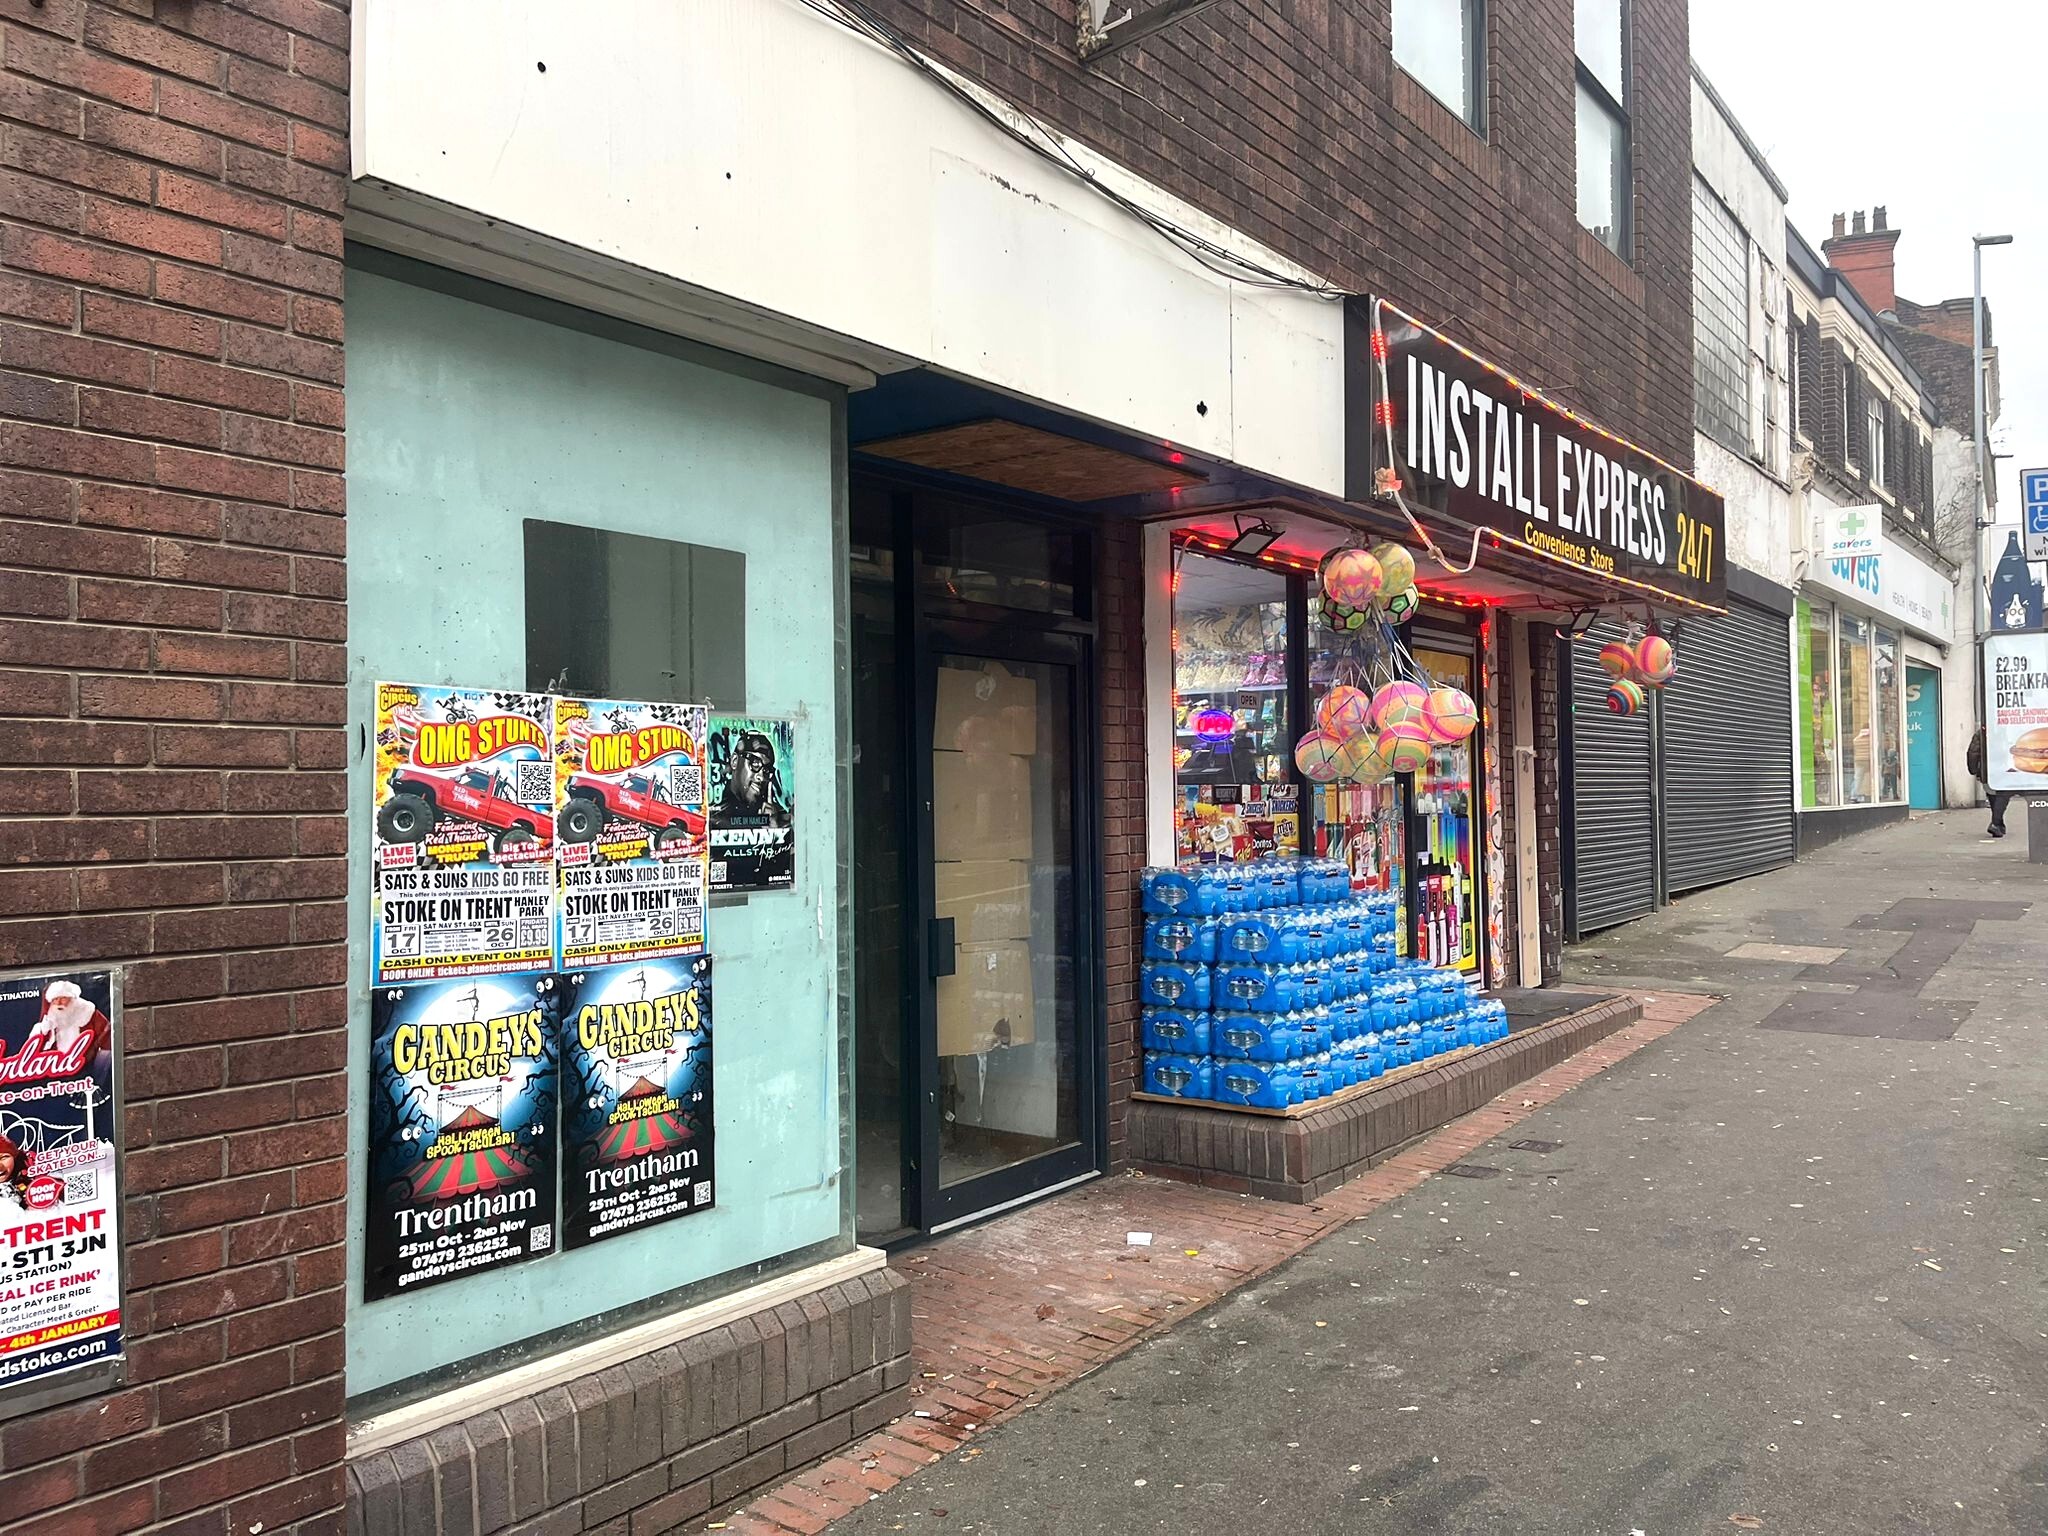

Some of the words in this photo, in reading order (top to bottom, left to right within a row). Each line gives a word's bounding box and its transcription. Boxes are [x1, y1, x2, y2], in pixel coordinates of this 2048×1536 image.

[1407, 353, 1549, 522] INSTALL
[1556, 434, 1665, 565] EXPRESS
[1525, 521, 1586, 563] Convenience
[1590, 545, 1614, 572] Store
[1676, 512, 1713, 583] 24/7
[1832, 539, 1872, 550] savers
[1996, 656, 2027, 673] £2.99
[380, 692, 418, 711] CIRCUS
[1240, 695, 1257, 706] OPEN
[1997, 692, 2027, 708] DEAL
[557, 707, 589, 724] CIRCUS
[1997, 709, 2021, 717] SAUSAGE
[1997, 717, 2009, 725] AND
[2010, 716, 2035, 724] SELECTED
[419, 724, 470, 765] OMG
[478, 718, 544, 754] STUNTS
[589, 734, 632, 771] OMG
[638, 728, 693, 761] STUNTS
[434, 821, 478, 834] Featuring
[603, 822, 640, 833] Featuring
[425, 832, 445, 844] Red
[447, 831, 489, 843] Thunder
[595, 833, 614, 844] Red
[616, 831, 650, 843] Thunder
[660, 841, 675, 850] Big
[675, 839, 692, 848] Top
[710, 828, 790, 846] KENNY
[1252, 839, 1273, 849] Doritos
[383, 845, 414, 857] LIVE
[428, 841, 487, 854] MONSTER
[502, 843, 520, 853] Big
[520, 841, 540, 852] Top
[562, 845, 588, 856] LIVE
[598, 840, 648, 853] MONSTER
[605, 849, 642, 860] TRUCK
[649, 845, 703, 859] Spectacular!
[723, 848, 775, 858] ALLSTAR
[383, 856, 415, 866] SHOW
[436, 851, 479, 864] TRUCK
[489, 848, 553, 864] Spectacular!
[563, 854, 589, 864] SHOW
[385, 873, 417, 891] SATS
[421, 873, 431, 890] &
[434, 872, 468, 889] SUNS
[472, 871, 499, 888] KIDS
[502, 871, 519, 887] GO
[522, 870, 550, 886] FREE
[565, 871, 595, 886] SATS
[595, 870, 603, 884] &
[605, 868, 633, 883] SUNS
[636, 866, 659, 881] KIDS
[662, 865, 677, 880] GO
[678, 864, 701, 879] FREE
[514, 895, 550, 907] HANLEY
[672, 887, 700, 898] HANLEY
[385, 899, 436, 924] STOKE
[440, 898, 462, 921] ON
[465, 896, 513, 920] TRENT
[565, 893, 608, 916] STOKE
[611, 892, 629, 913] ON
[631, 889, 671, 911] TRENT
[676, 897, 698, 907] PARK
[519, 906, 545, 917] PARK
[568, 924, 592, 938] 17
[649, 916, 673, 931] 26
[387, 932, 416, 948] 17
[486, 927, 514, 942] 26
[520, 928, 548, 946] £9.99
[565, 946, 596, 956] CASH
[599, 943, 627, 952] ONLY
[629, 939, 662, 949] EVENT
[664, 937, 679, 945] ON
[681, 935, 702, 943] SITE
[383, 958, 421, 968] CASH
[425, 955, 458, 965] ONLY
[461, 952, 500, 962] EVENT
[503, 951, 521, 959] ON
[524, 949, 550, 958] SITE
[382, 969, 406, 981] BOOK
[407, 966, 436, 979] ONLINE
[578, 987, 700, 1050] GANDEYS
[393, 1007, 544, 1075] GANDEYS
[608, 1028, 674, 1058] CIRCUS
[428, 1052, 511, 1085] CIRCUS
[37, 1150, 60, 1161] GET
[64, 1140, 97, 1155] YOUR
[28, 1158, 76, 1176] SKATES
[585, 1147, 699, 1194] Trentham
[30, 1183, 55, 1194] BOOK
[588, 1196, 617, 1212] 25TH
[618, 1188, 640, 1204] Oct
[648, 1183, 668, 1196] 2ND
[669, 1176, 691, 1190] Nov
[32, 1192, 54, 1203] NOW
[394, 1187, 537, 1238] Trentham
[599, 1203, 635, 1222] 07479
[636, 1191, 678, 1213] 236252
[589, 1200, 688, 1238] gandeyscircus.com
[398, 1240, 434, 1258] 25TH
[436, 1231, 463, 1249] Oct
[473, 1225, 498, 1241] 2ND
[500, 1219, 526, 1234] Nov
[12, 1244, 54, 1269] ST1
[61, 1233, 106, 1258] 3JN
[411, 1248, 456, 1270] 07479
[457, 1235, 509, 1259] 236252
[16, 1260, 72, 1281] STATION)
[398, 1245, 522, 1287] gandeyscircus.com
[30, 1279, 56, 1295] ICE
[11, 1304, 21, 1312] or
[24, 1298, 44, 1309] PAY
[46, 1292, 66, 1304] PER
[68, 1286, 92, 1298] RIDE
[21, 1306, 57, 1320] Licensed
[58, 1302, 71, 1311] Bar
[6, 1319, 45, 1334] Character
[47, 1313, 66, 1323] Meet
[9, 1334, 36, 1348] 4th
[38, 1315, 108, 1342] JANUARY
